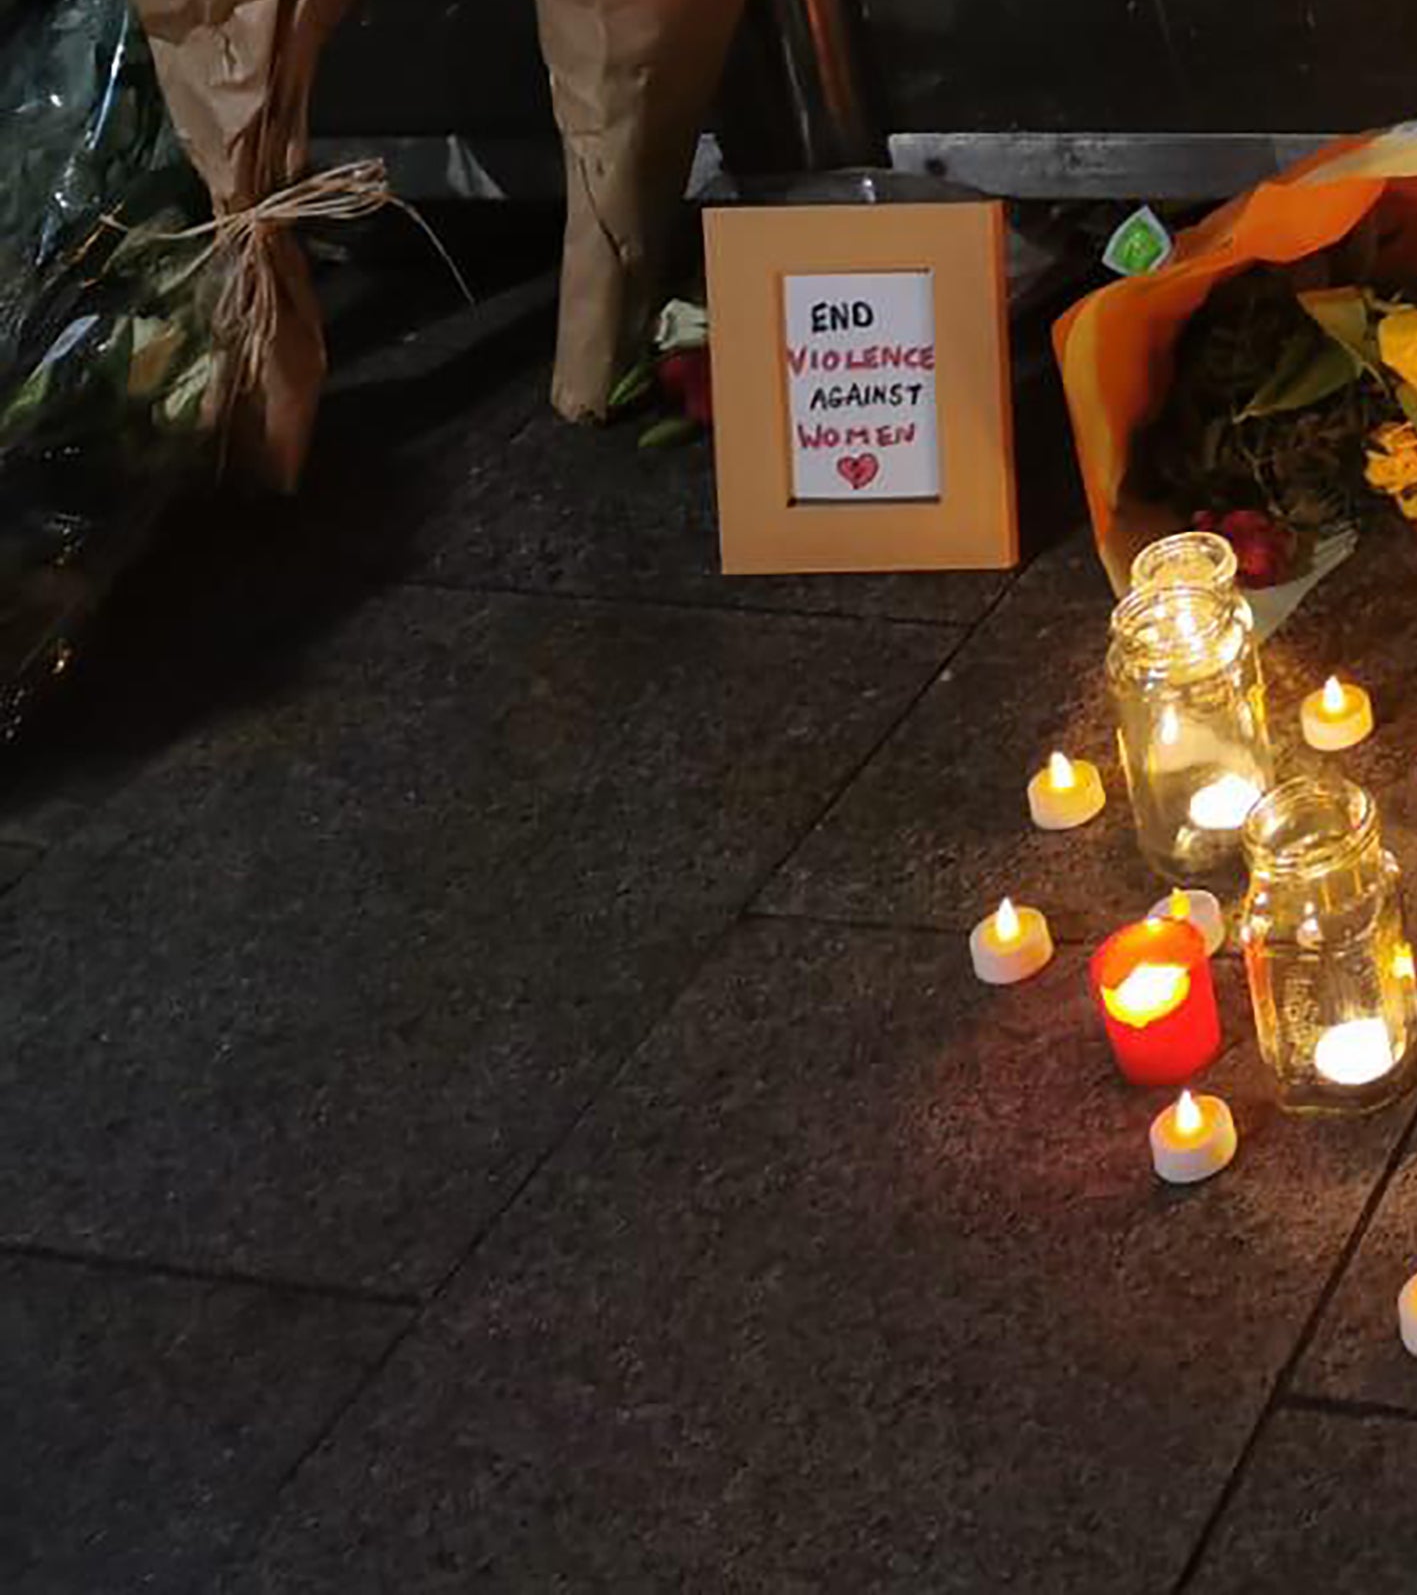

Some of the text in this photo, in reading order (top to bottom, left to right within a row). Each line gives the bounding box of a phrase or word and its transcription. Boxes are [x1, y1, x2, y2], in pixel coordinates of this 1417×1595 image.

[810, 301, 874, 334] END
[787, 344, 936, 376] VIOLENCE
[810, 382, 922, 410] AGAINST
[797, 422, 916, 448] WOMEN
